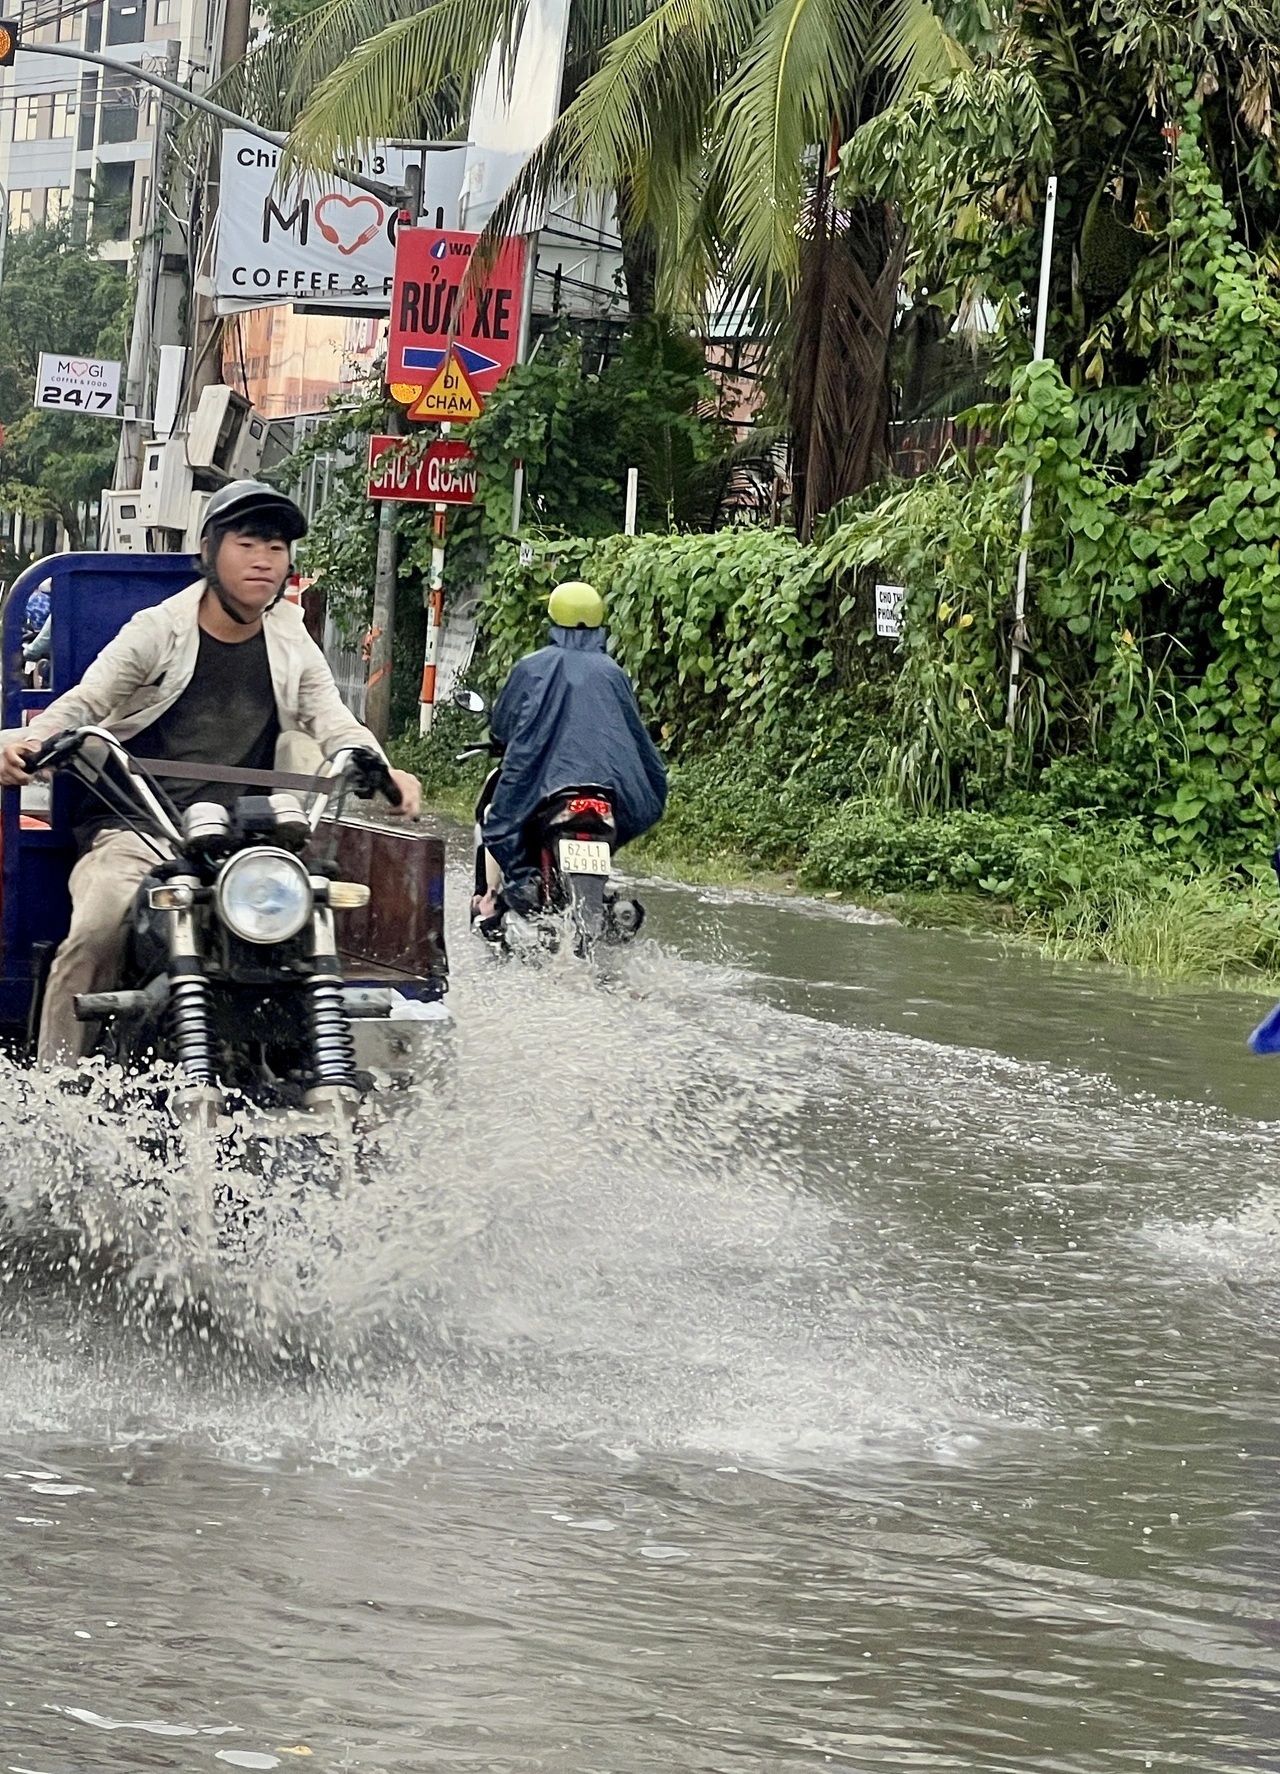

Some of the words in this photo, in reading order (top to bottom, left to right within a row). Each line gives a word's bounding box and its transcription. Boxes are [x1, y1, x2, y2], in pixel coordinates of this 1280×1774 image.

[232, 266, 340, 291] COFFEE
[399, 265, 462, 337] RỬA
[471, 287, 513, 340] XE
[42, 386, 113, 409] 24/7
[568, 843, 600, 857] 62-L1
